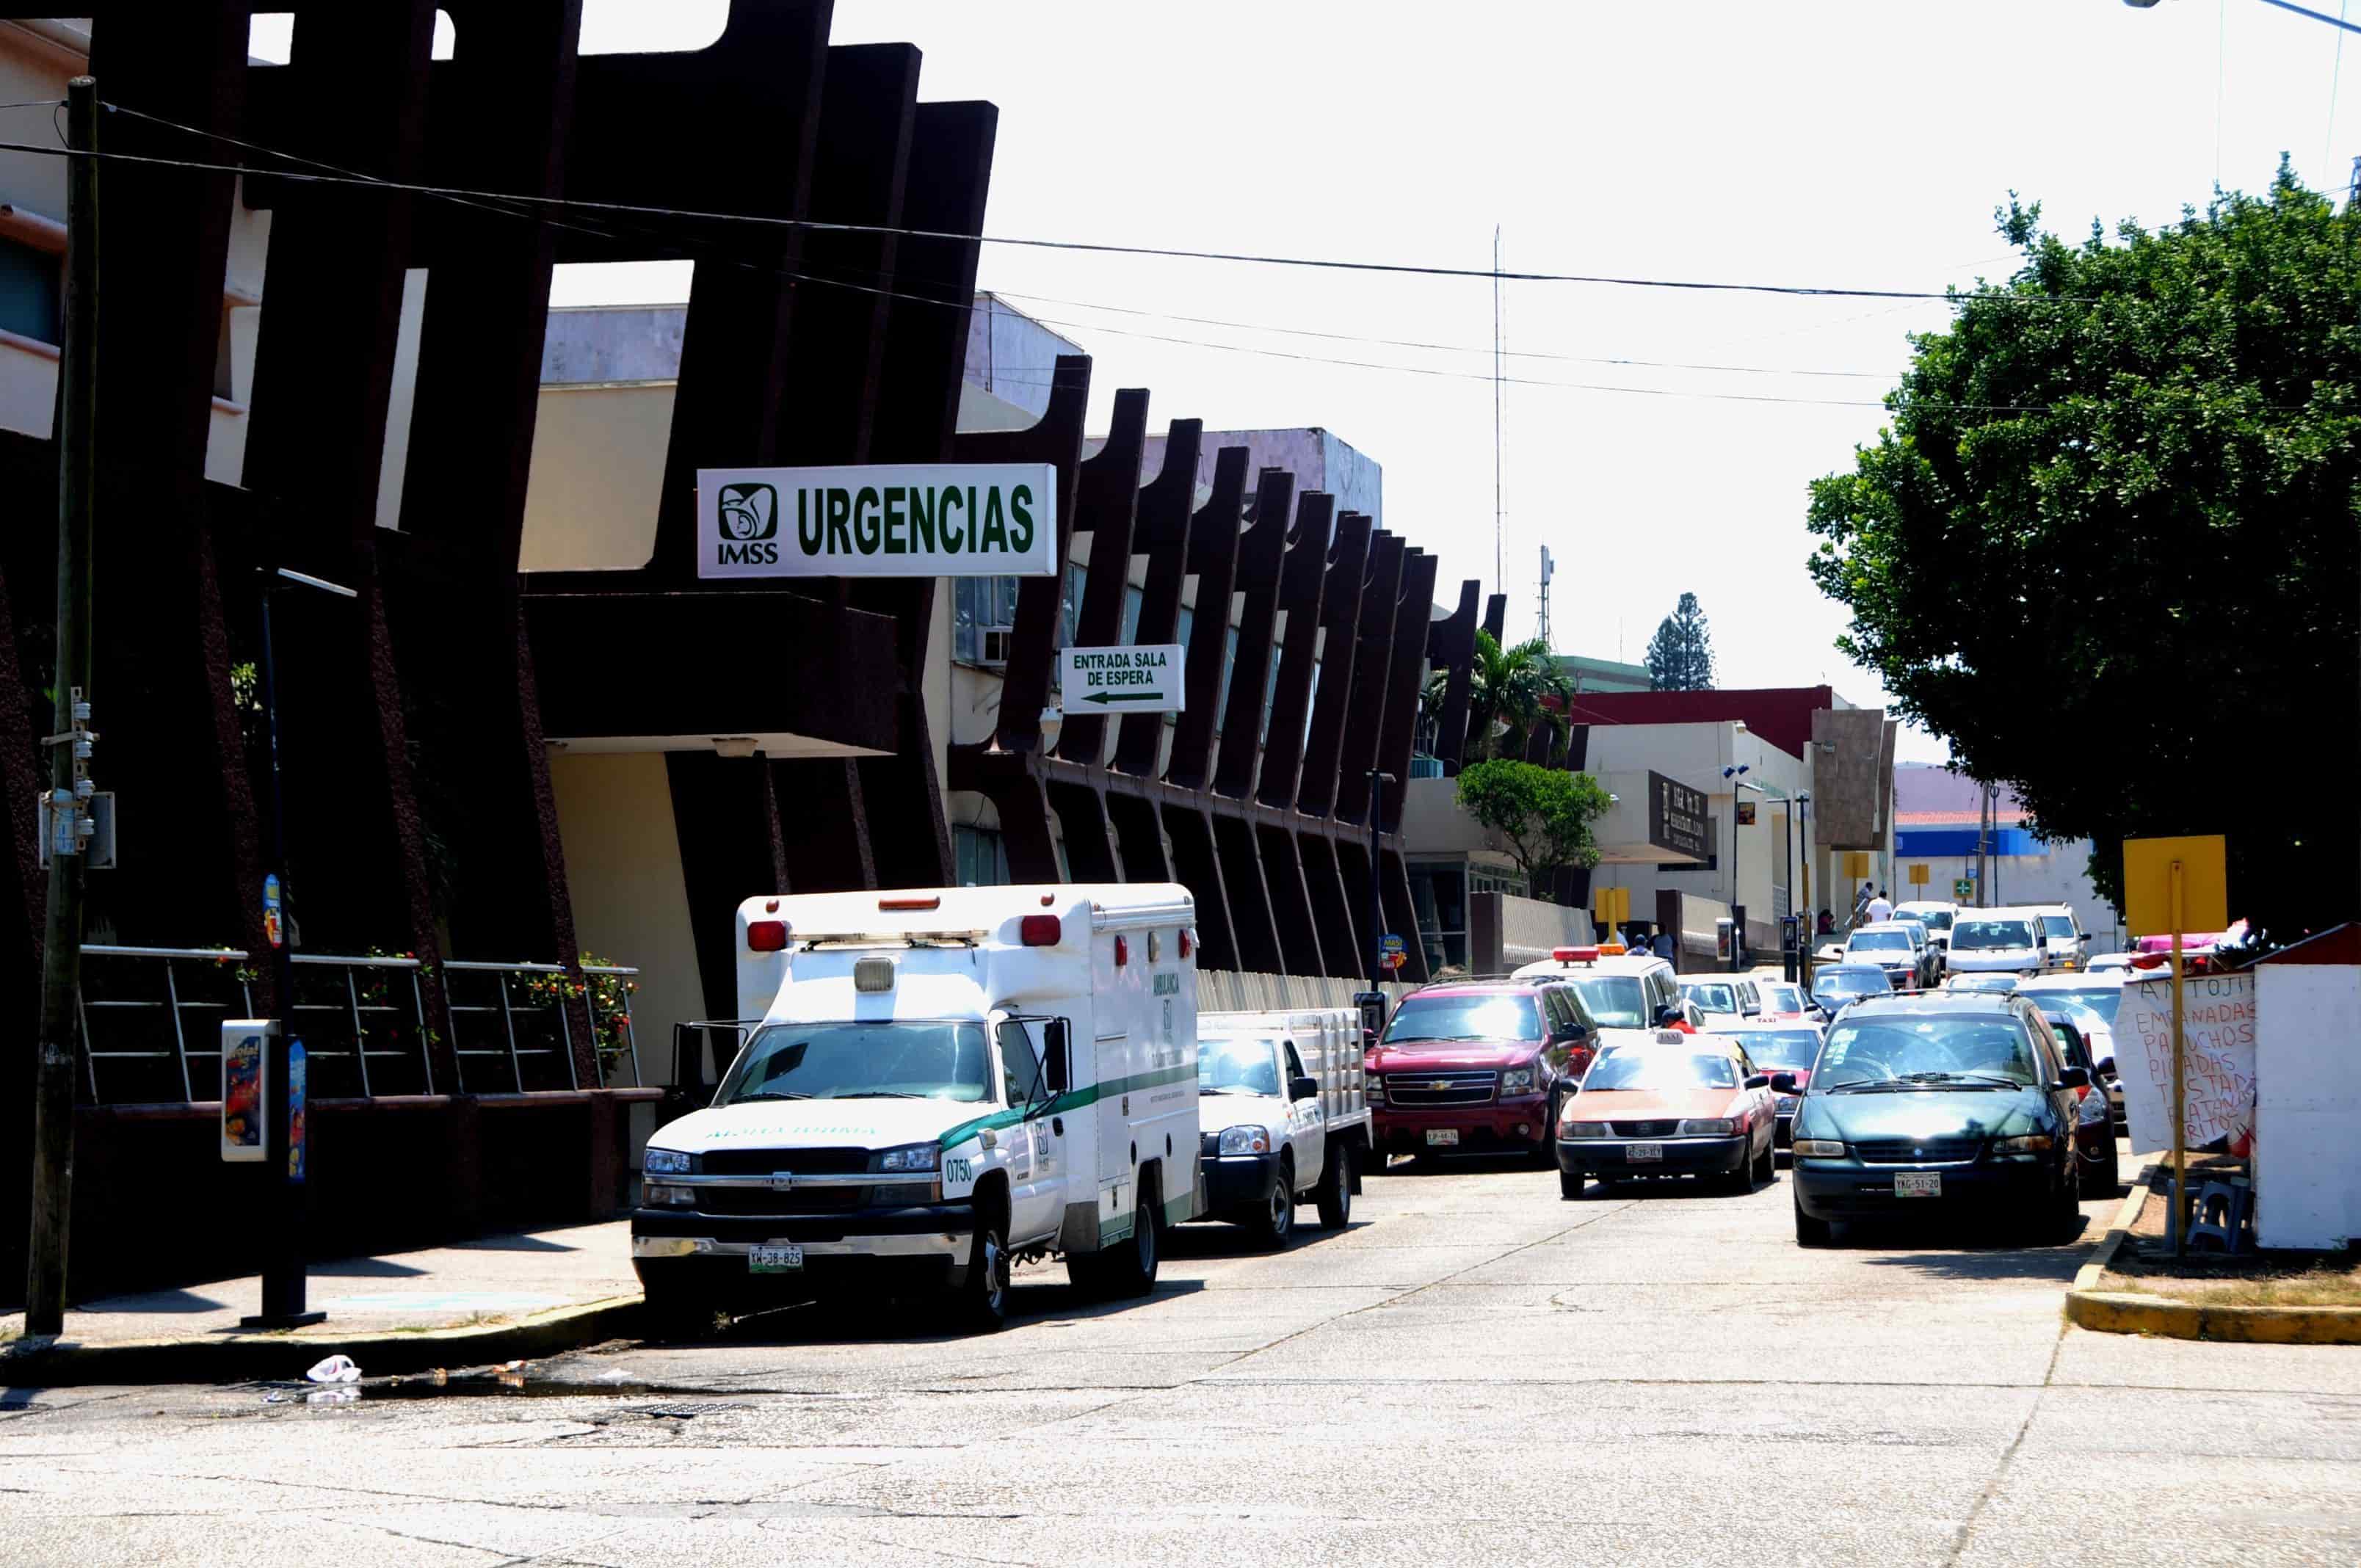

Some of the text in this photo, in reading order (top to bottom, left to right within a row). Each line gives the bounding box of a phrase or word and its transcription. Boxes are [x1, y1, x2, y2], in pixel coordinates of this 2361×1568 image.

[797, 484, 1034, 556] URGENCIAS
[718, 543, 778, 565] IMSS
[1074, 652, 1167, 669] ENTRADA SALA
[1087, 669, 1153, 686] DE ESPERA
[1660, 1033, 1680, 1041] TAXI
[946, 1158, 972, 1183] 0750
